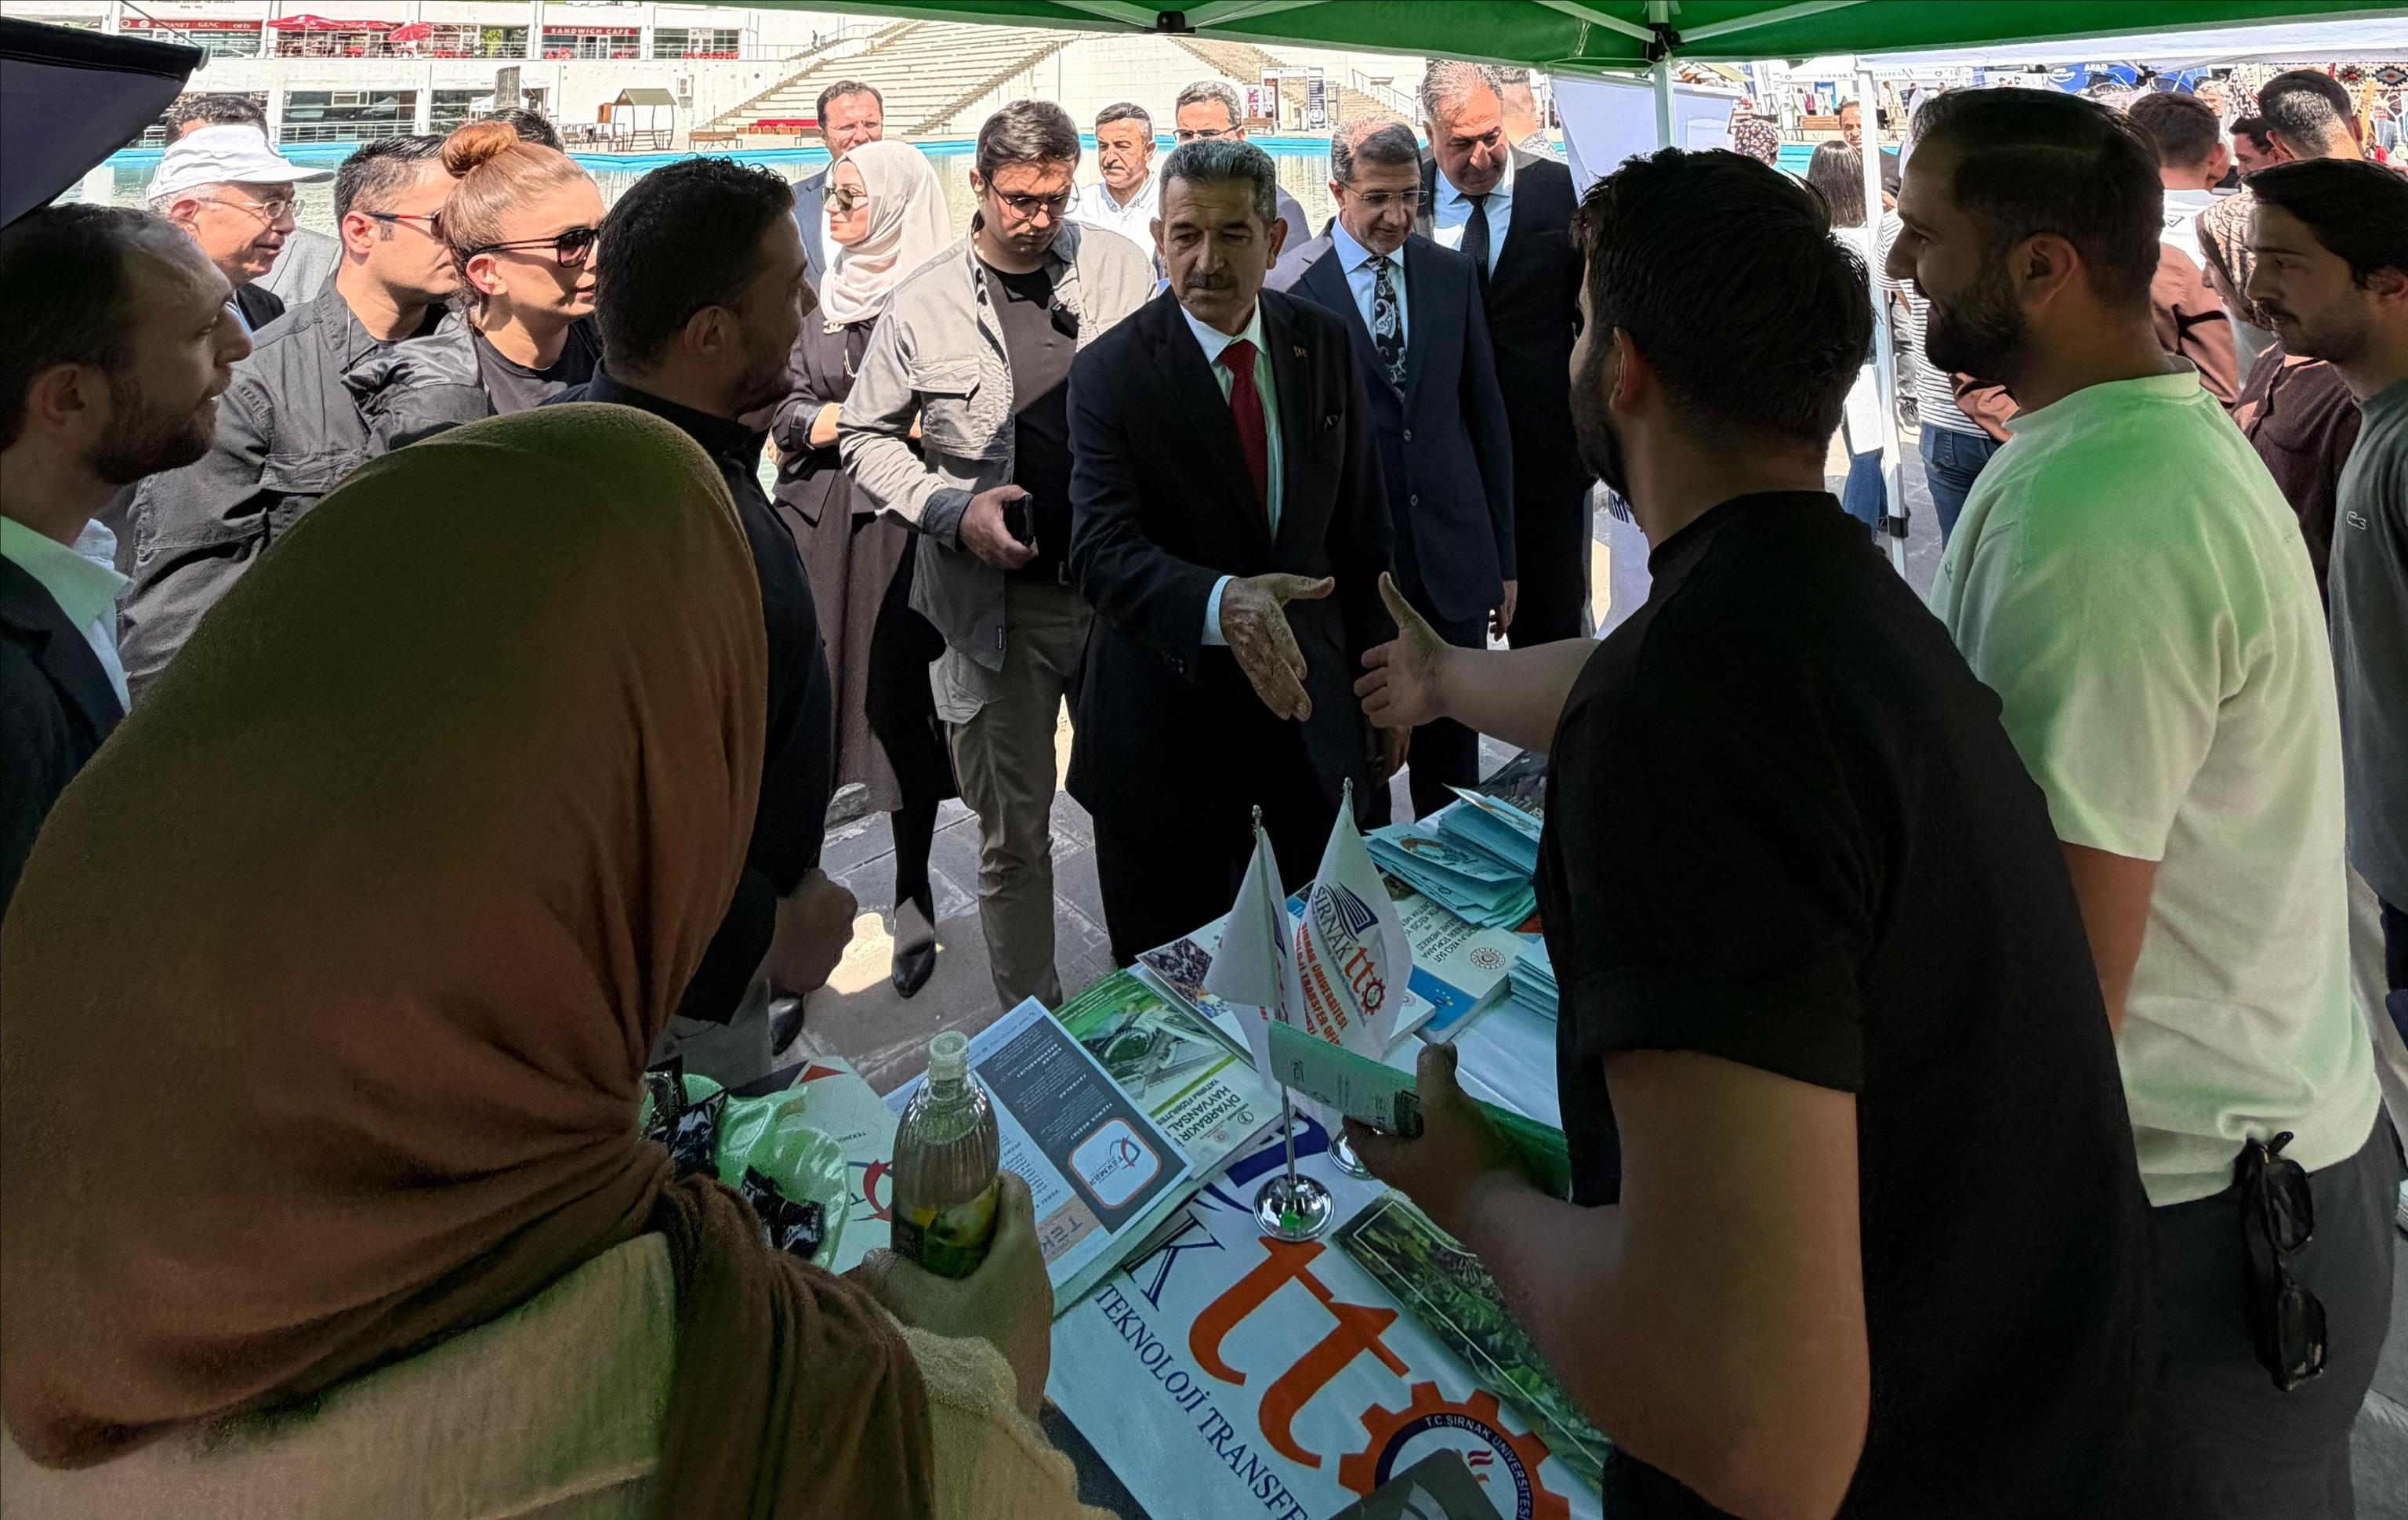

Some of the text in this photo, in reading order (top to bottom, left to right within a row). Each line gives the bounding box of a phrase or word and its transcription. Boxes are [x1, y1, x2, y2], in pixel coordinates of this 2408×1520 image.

[1167, 1086, 1231, 1131] HAYVANSAL
[1179, 1094, 1241, 1141] DİYARBAKIR
[1095, 1283, 1210, 1415] TEKNOLOJİ
